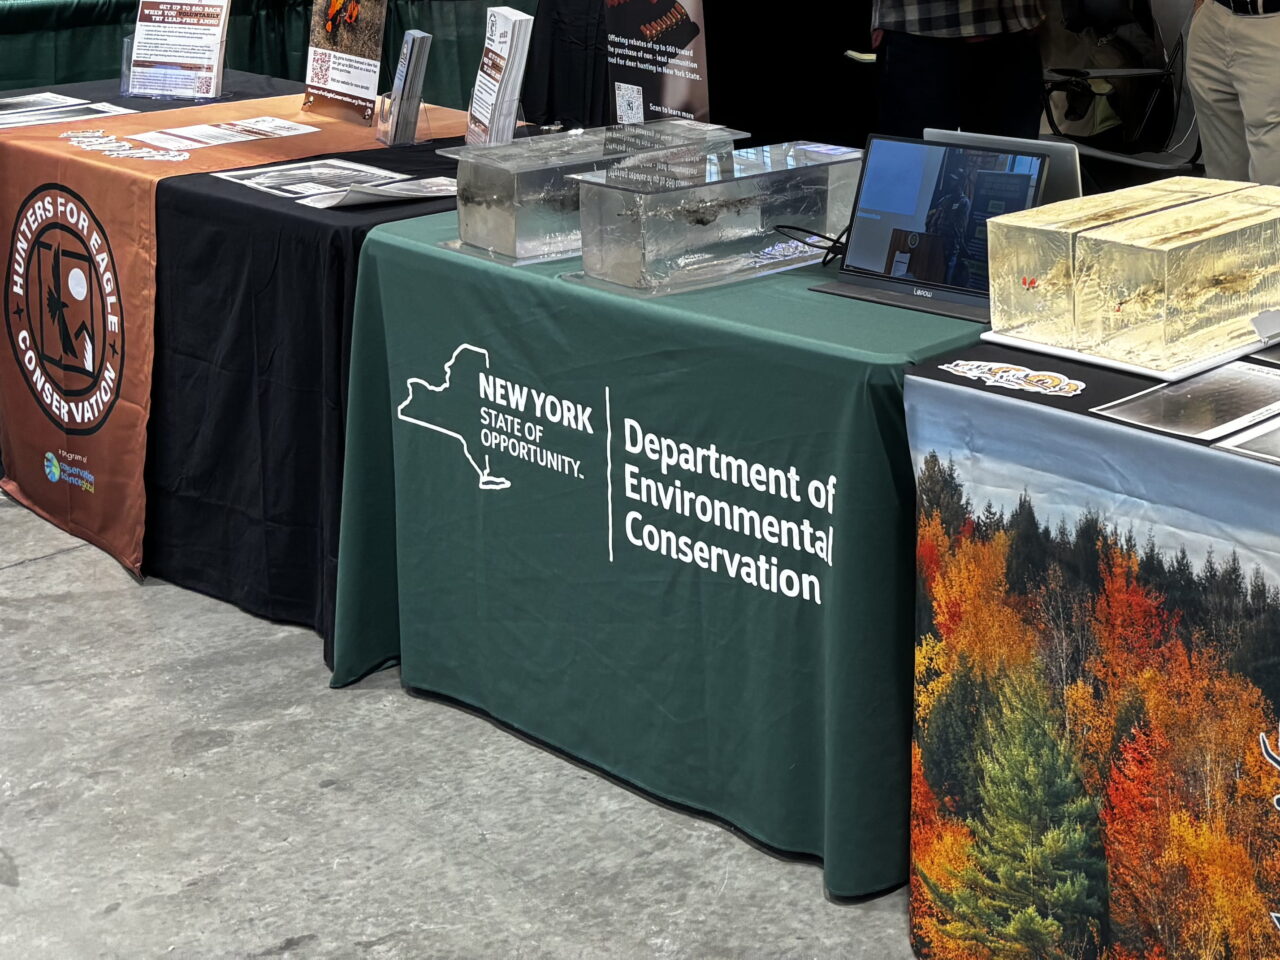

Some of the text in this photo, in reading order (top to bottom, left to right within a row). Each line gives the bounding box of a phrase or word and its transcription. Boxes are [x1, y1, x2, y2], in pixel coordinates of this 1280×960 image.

[608, 34, 628, 45] Offering
[629, 38, 646, 47] rebates
[647, 41, 652, 49] of
[666, 45, 675, 53] $60
[676, 47, 693, 57] toward
[13, 196, 118, 333] HUNTERS FOR EAGLE
[18, 330, 116, 423] CONSERVATION
[479, 372, 593, 434] NEW YORK
[480, 407, 543, 442] STATE OF
[624, 418, 837, 513] Department of
[624, 463, 833, 566] Environmental
[625, 511, 821, 604] Conservation
